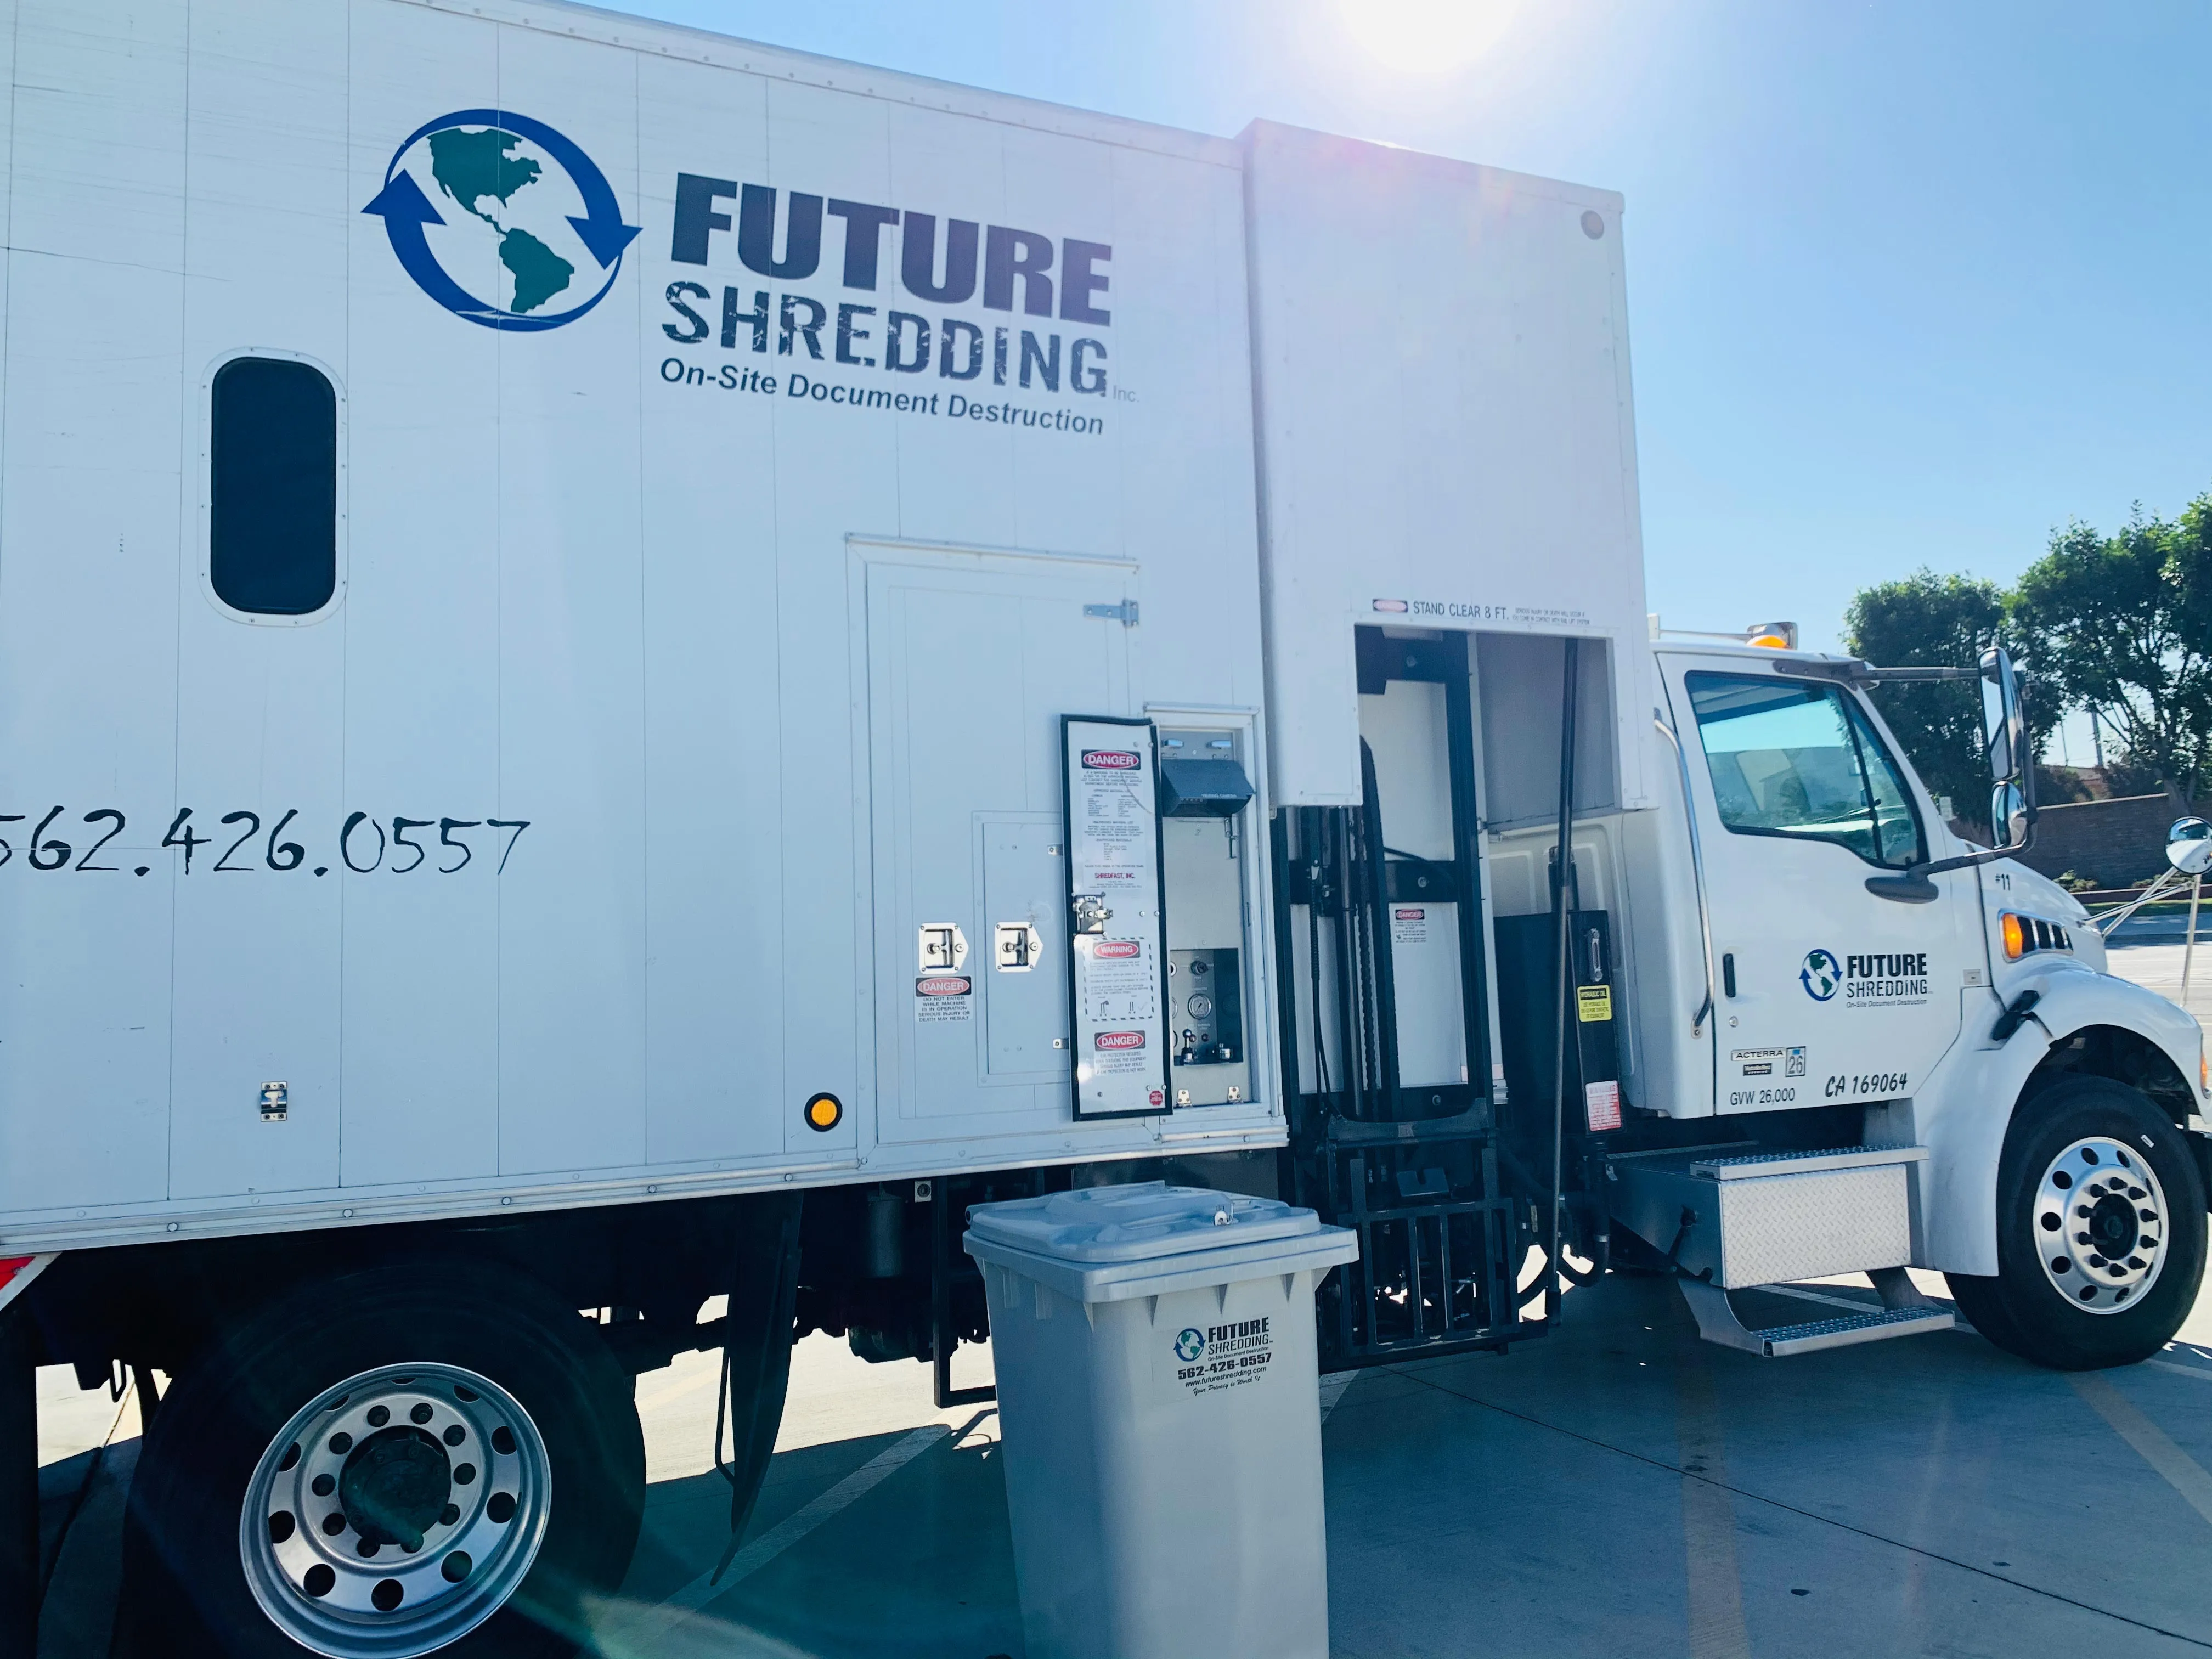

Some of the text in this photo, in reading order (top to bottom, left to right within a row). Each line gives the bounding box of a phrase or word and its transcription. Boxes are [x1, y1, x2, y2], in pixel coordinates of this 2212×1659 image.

[672, 172, 1112, 326] FUTURE
[661, 281, 1140, 403] SHREDDING Inc.
[660, 357, 1104, 435] On-Site Document Destruction
[1413, 600, 1445, 615] STAND
[1449, 603, 1481, 618] CLEAR
[1484, 606, 1491, 619] 8
[1495, 607, 1509, 620] FT.
[1088, 754, 1133, 765] DANGER
[1995, 873, 2011, 891] #11
[1101, 945, 1133, 953] WARNING
[1847, 953, 1928, 978] FUTURE
[923, 982, 965, 991] DANGER
[1846, 979, 1928, 998] SHREDDING
[1101, 1036, 1138, 1046] DANGER
[1735, 1049, 1784, 1059] ACTERRA
[1788, 1055, 1803, 1074] 26
[1825, 1072, 1908, 1097] CA 169064
[1730, 1088, 1795, 1106] GVW 26,000
[1208, 1317, 1269, 1344] FUTURE
[1208, 1334, 1269, 1355] SHREDDING
[1224, 1350, 1245, 1359] Document
[1246, 1346, 1269, 1355] Destruction
[1178, 1352, 1272, 1380] 562-426-0557
[1185, 1365, 1267, 1387] www.futureshredding.com
[1193, 1387, 1206, 1396] Your
[1207, 1383, 1229, 1392] Privacy
[1236, 1376, 1252, 1386] Worth
